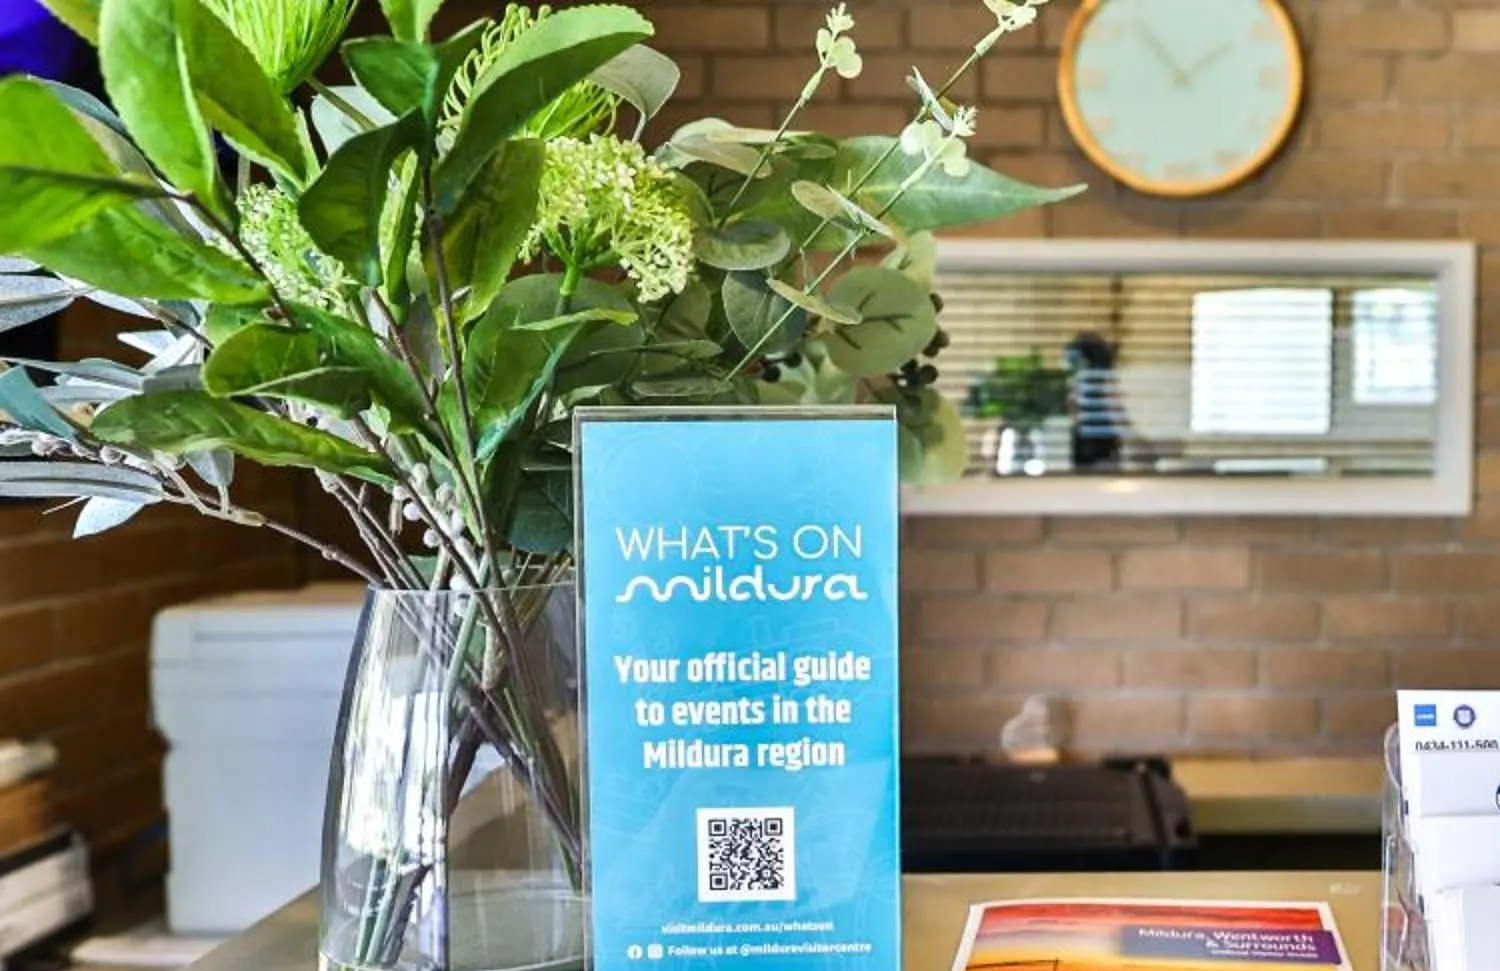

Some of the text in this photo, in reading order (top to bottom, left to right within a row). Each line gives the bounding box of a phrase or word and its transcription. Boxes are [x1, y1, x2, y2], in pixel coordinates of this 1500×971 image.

[615, 524, 862, 561] WHAT'S ON
[615, 564, 869, 602] mildura
[613, 651, 871, 686] Your official guide
[635, 695, 851, 727] to events in the
[643, 737, 845, 771] Mildura region
[668, 944, 706, 957] Follow
[709, 946, 723, 956] us
[726, 944, 738, 956] at
[1205, 938, 1317, 951] & Surrounds
[1212, 930, 1314, 943] Wentworth
